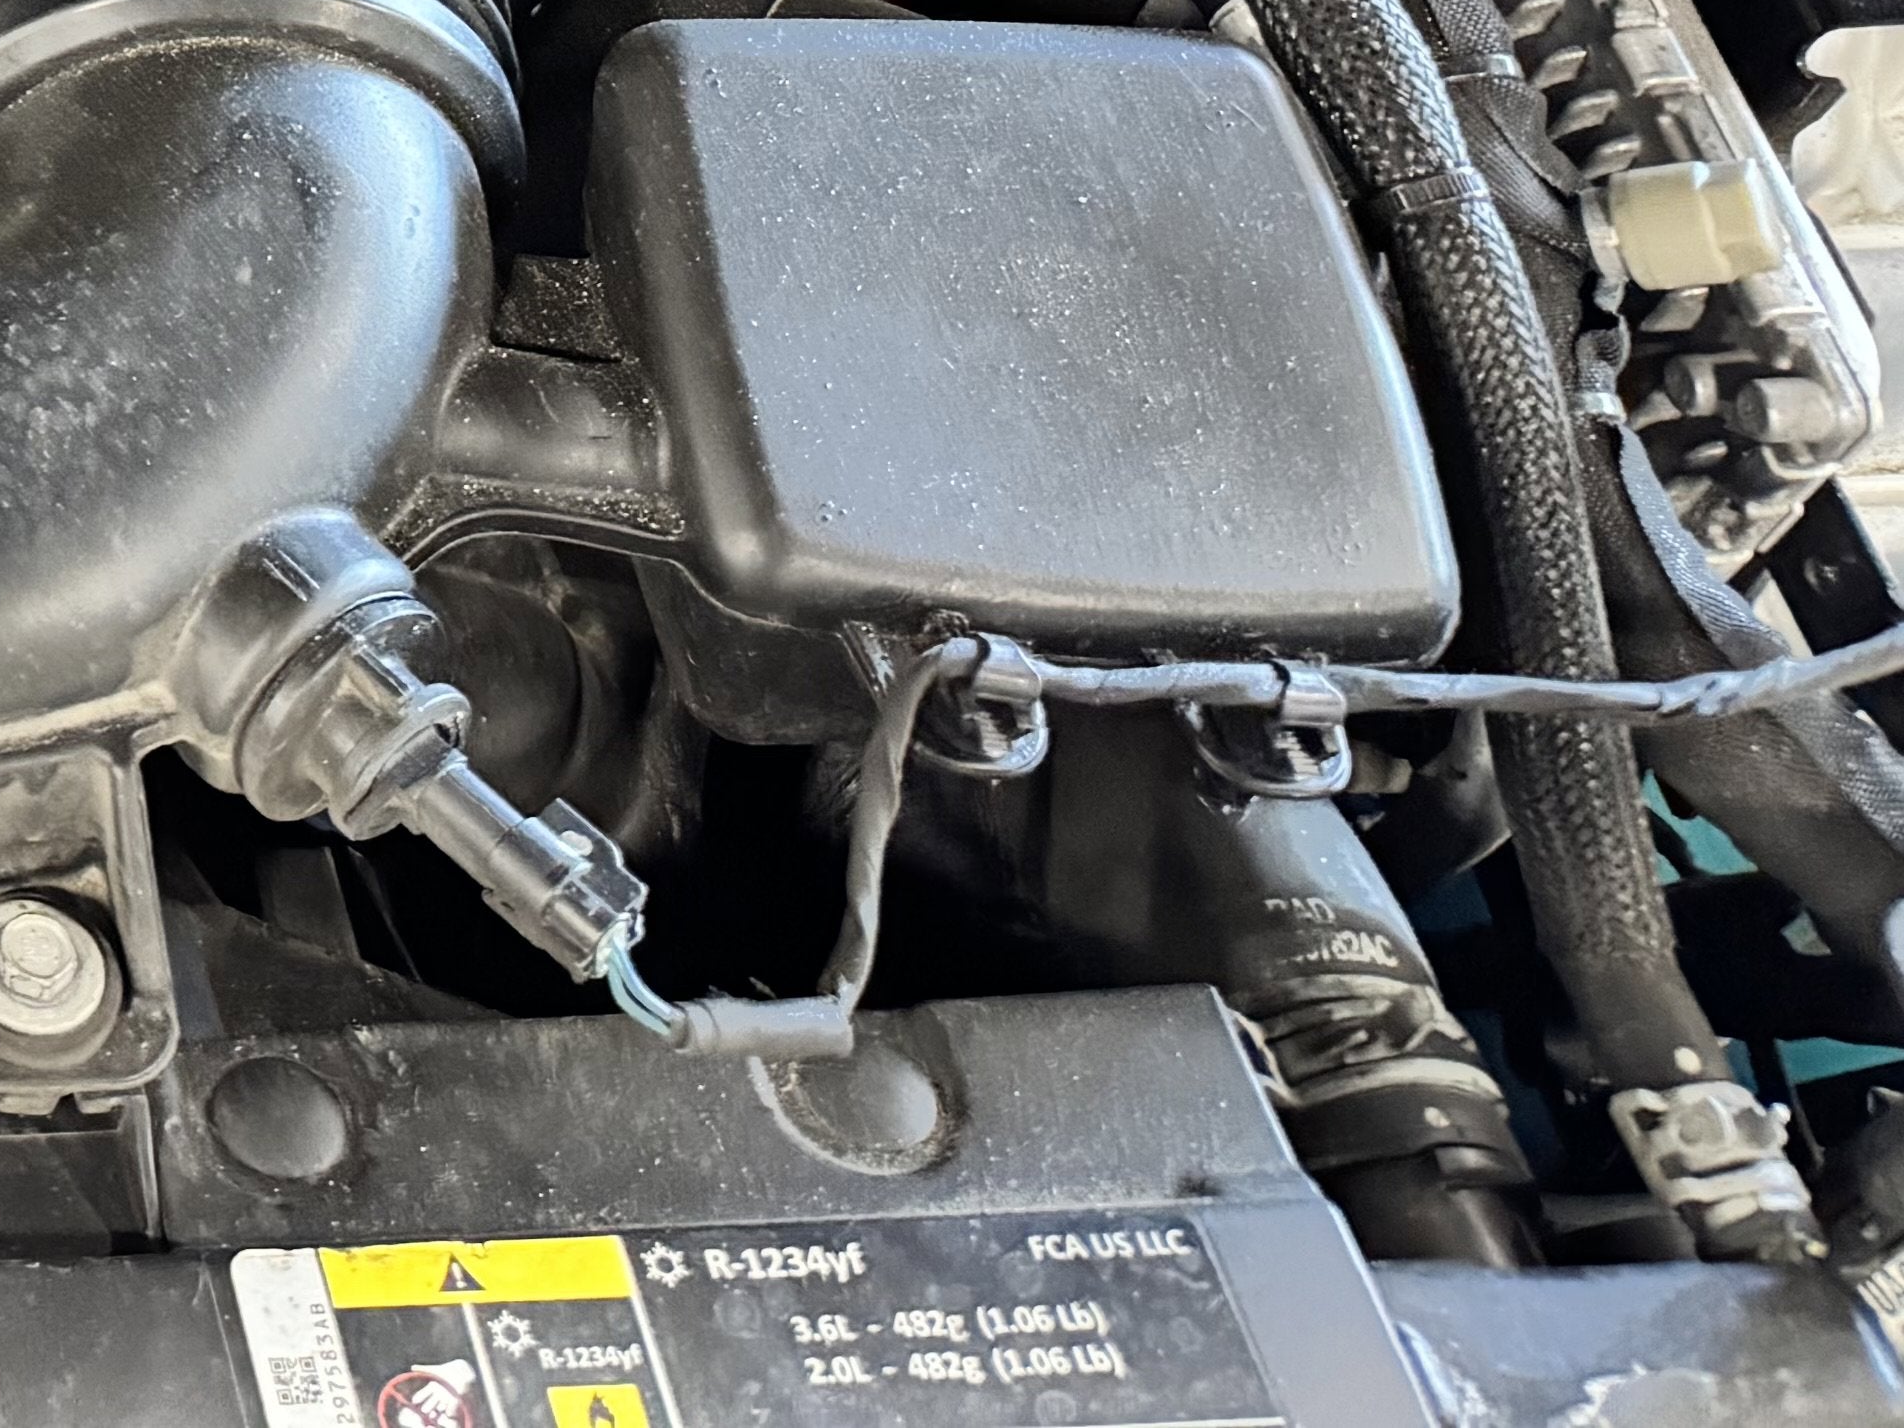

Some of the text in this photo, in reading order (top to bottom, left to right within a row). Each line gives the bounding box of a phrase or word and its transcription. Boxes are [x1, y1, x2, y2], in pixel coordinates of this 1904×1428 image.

[703, 1227, 1192, 1284] R-1234yf FCA US LLC
[789, 1313, 859, 1345] 3.6L
[892, 1309, 970, 1345] 482g
[977, 1303, 1054, 1339] (1.06
[1054, 1300, 1109, 1337] Lb)
[538, 1341, 644, 1373] R-1234yf
[803, 1355, 873, 1386] 2.0L
[907, 1351, 987, 1386] 482g
[993, 1346, 1070, 1383] (1.06
[1070, 1342, 1126, 1380] Lb)
